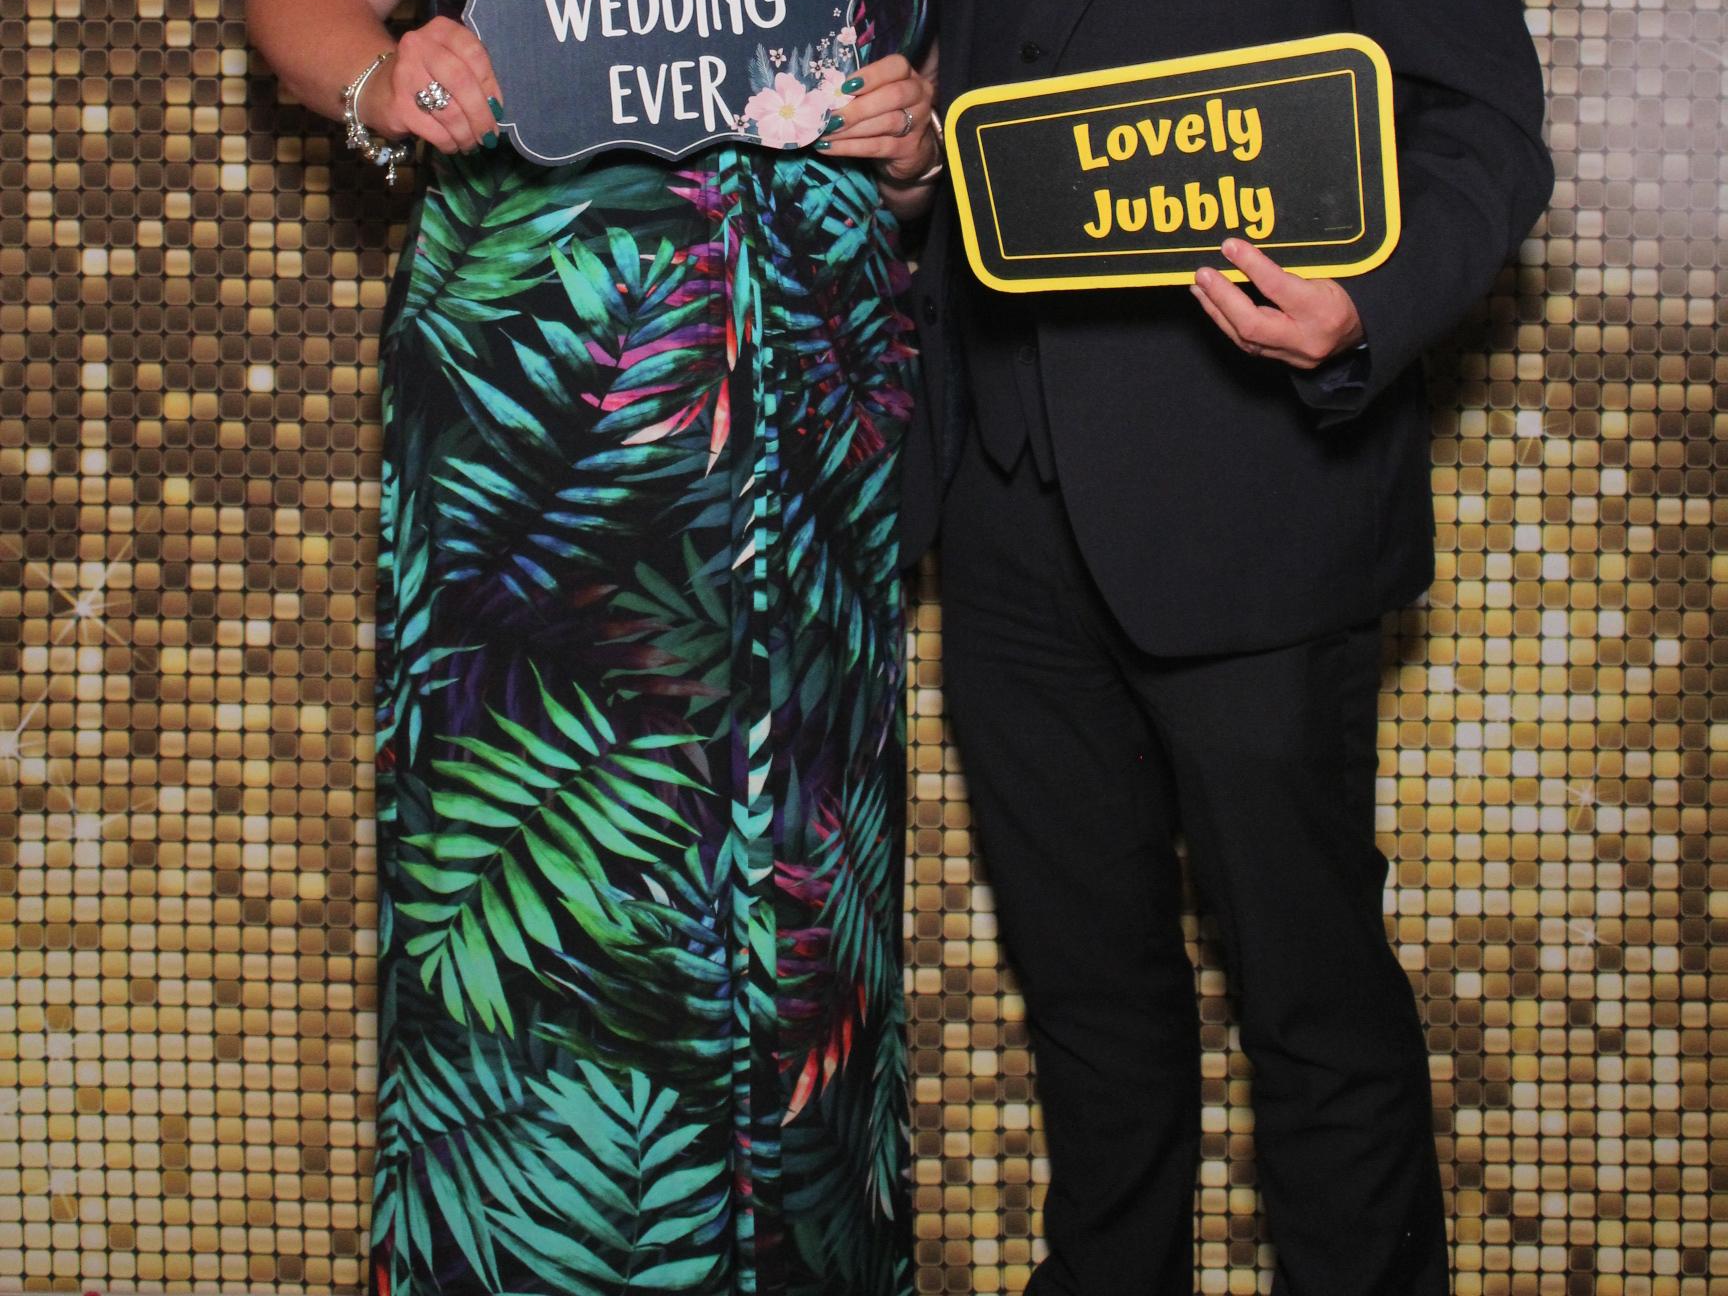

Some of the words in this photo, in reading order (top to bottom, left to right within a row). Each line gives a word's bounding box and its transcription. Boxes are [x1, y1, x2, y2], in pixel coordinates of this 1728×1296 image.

[609, 55, 736, 132] EVER
[1073, 98, 1263, 171] Lovely
[1083, 176, 1275, 239] Jubbly
